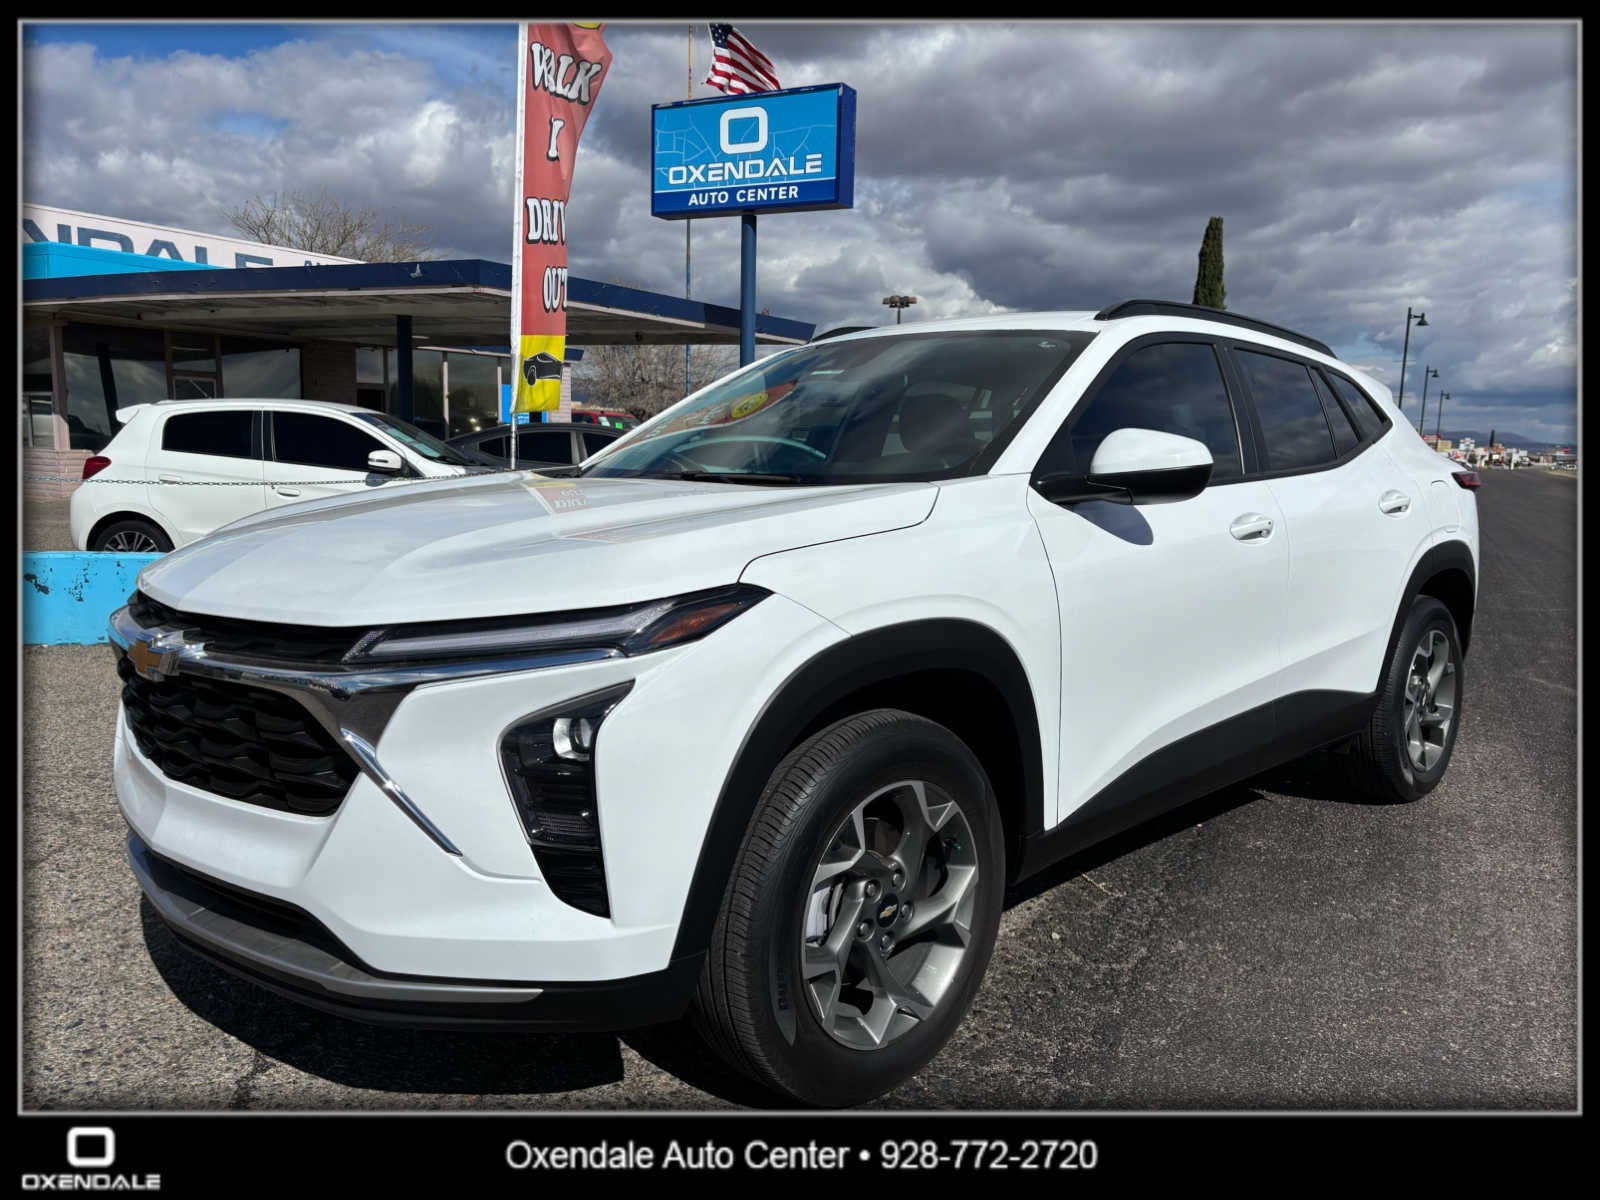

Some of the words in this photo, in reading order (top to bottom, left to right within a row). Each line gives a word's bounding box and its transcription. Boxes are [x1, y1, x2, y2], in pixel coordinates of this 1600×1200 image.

[668, 153, 823, 186] OXENDALE
[688, 190, 729, 206] AUTO
[736, 185, 799, 203] CENTER
